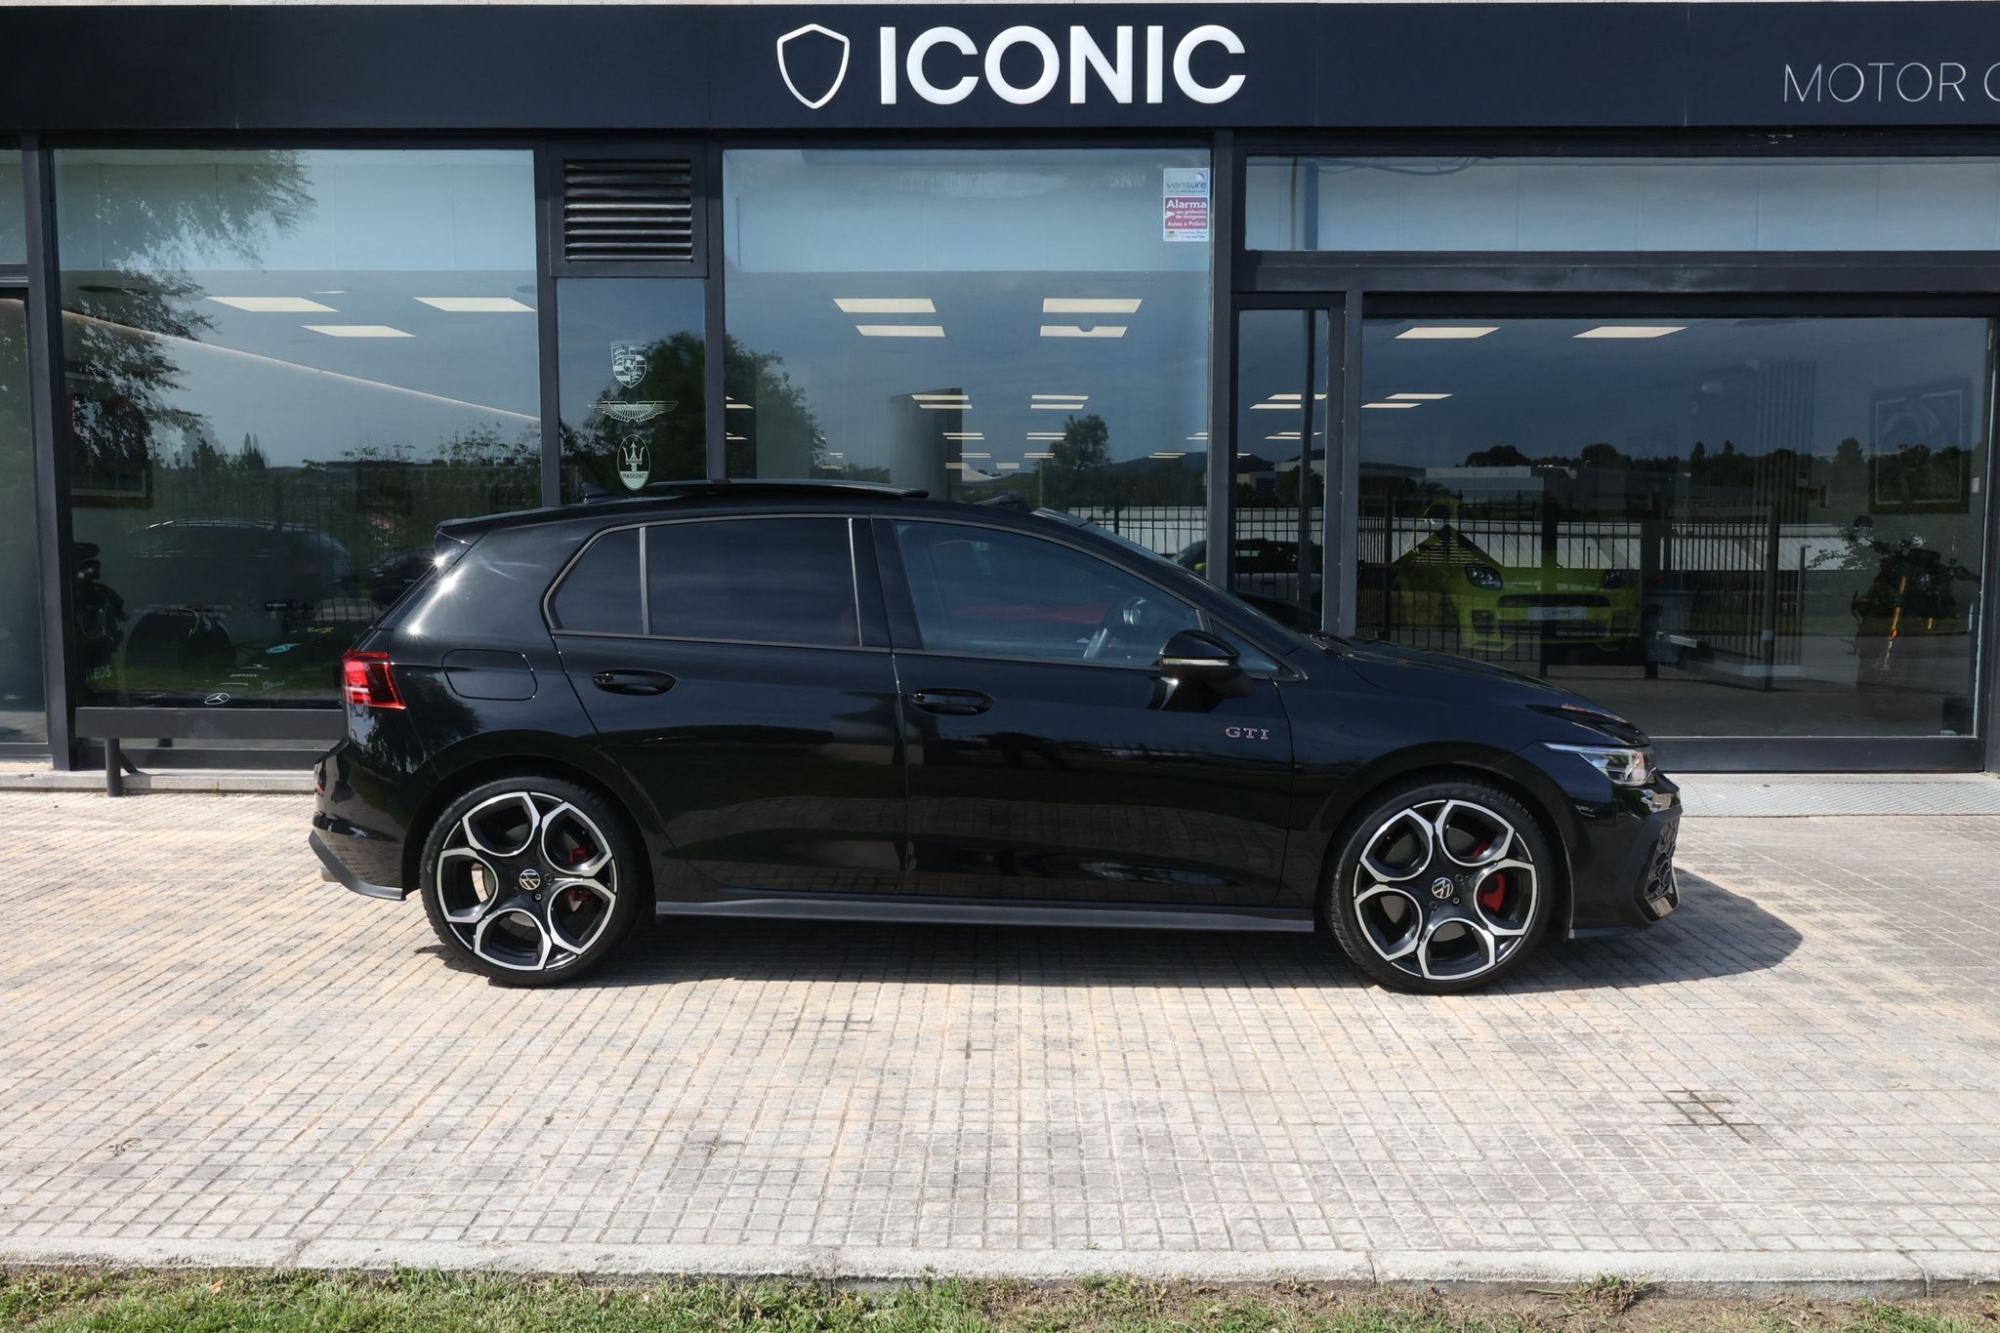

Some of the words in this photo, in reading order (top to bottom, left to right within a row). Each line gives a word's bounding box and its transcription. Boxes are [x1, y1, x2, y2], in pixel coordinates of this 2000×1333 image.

[880, 24, 1246, 105] ICONIC
[1784, 62, 1966, 103] MOTOR
[1166, 181, 1207, 189] verisure
[1166, 199, 1207, 209] Alarma
[1225, 726, 1270, 740] GTI
